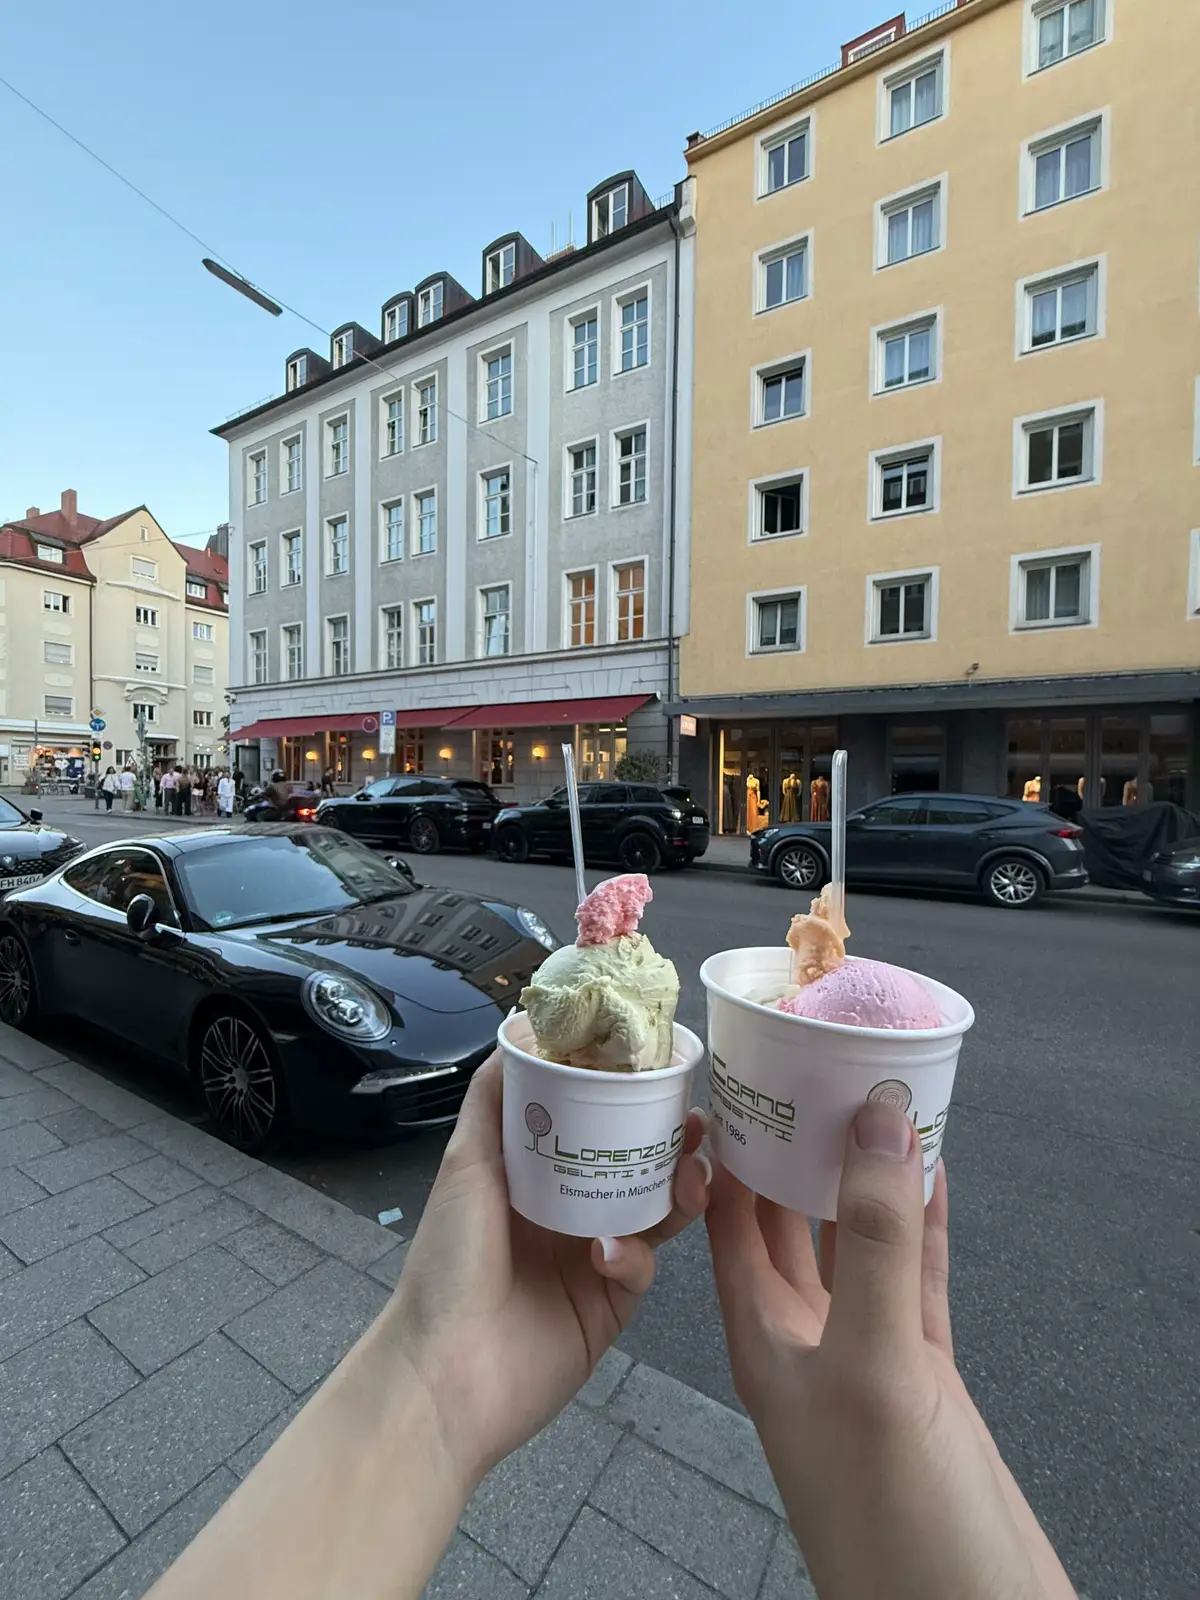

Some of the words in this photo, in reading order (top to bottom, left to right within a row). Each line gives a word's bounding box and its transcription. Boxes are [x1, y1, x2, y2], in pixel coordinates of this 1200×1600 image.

[383, 711, 392, 724] P
[725, 1120, 747, 1146] 1986
[553, 1163, 635, 1180] GELATI
[559, 1183, 614, 1200] Eismacher
[616, 1188, 626, 1199] in
[627, 1178, 667, 1198] München
